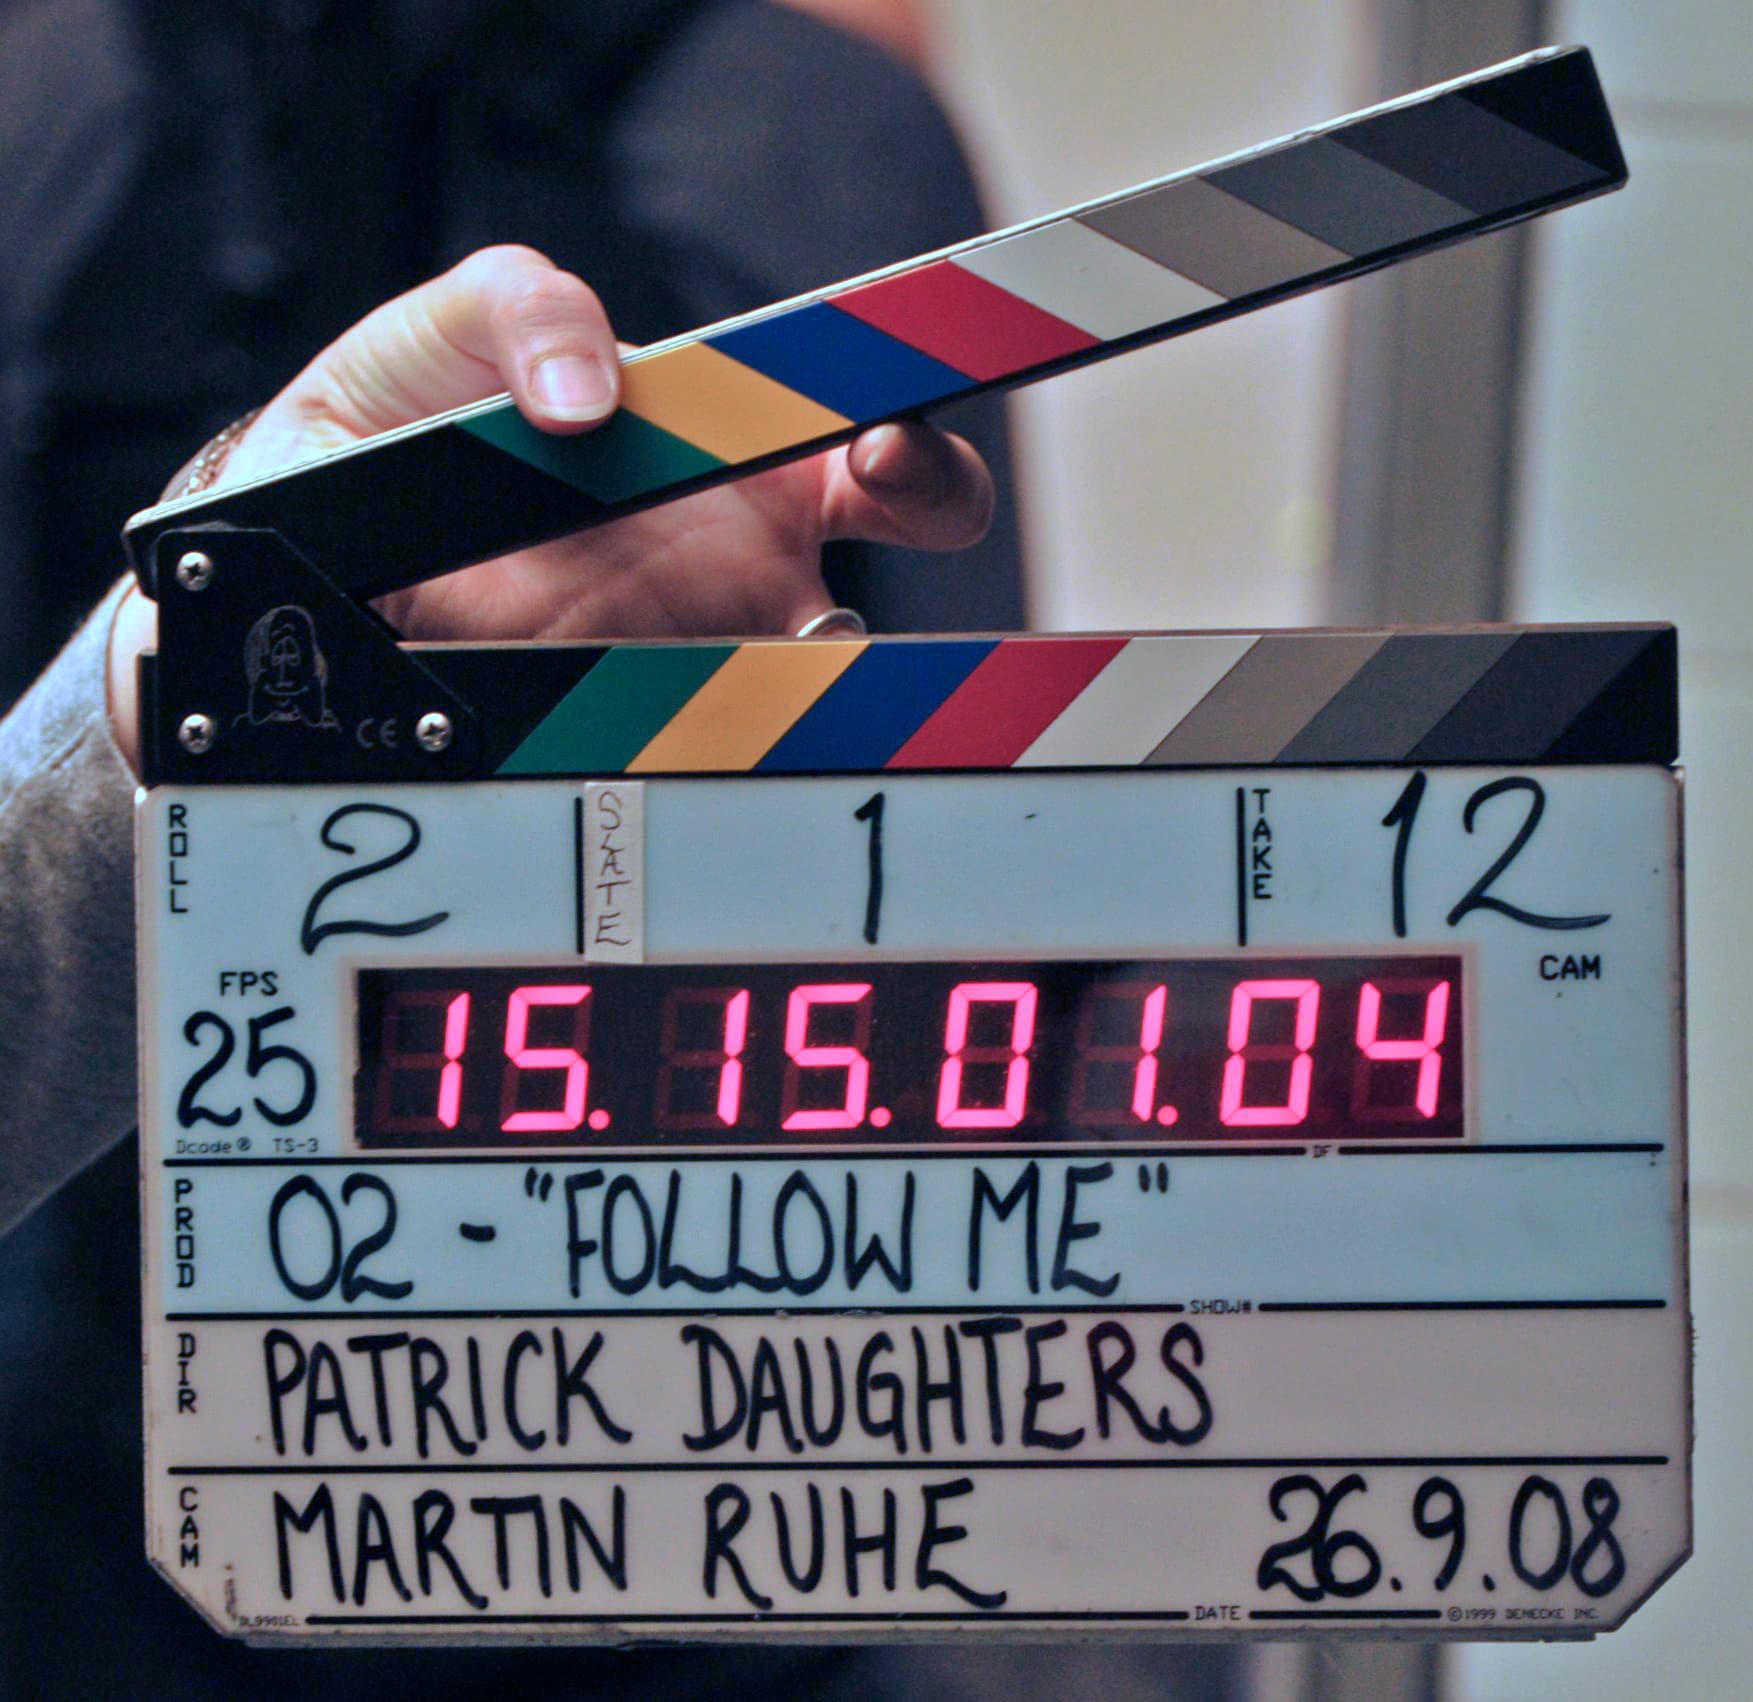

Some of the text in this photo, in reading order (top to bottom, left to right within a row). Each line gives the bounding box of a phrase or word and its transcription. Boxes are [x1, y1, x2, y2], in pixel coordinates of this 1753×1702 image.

[168, 803, 189, 914] ROLL
[300, 802, 450, 956] 2
[595, 790, 633, 946] SLATE
[853, 791, 886, 945] 1
[1251, 787, 1273, 901] TAKE
[1381, 770, 1613, 939] 12
[218, 970, 280, 998] FPS
[1538, 954, 1603, 982] CAM
[176, 1005, 318, 1129] 25
[272, 1137, 319, 1154] TS-3
[174, 1178, 196, 1289] PROD
[268, 1173, 414, 1303] 02
[177, 1332, 197, 1414] DIR
[263, 1317, 1213, 1460] PATRICK DAUGHTERS
[179, 1486, 200, 1568] CAM
[273, 1477, 1008, 1612] MARTIN RUHE
[1256, 1473, 1627, 1602] 26.9.08
[1195, 1605, 1241, 1621] DATE
[1505, 1608, 1565, 1620] DENECKE
